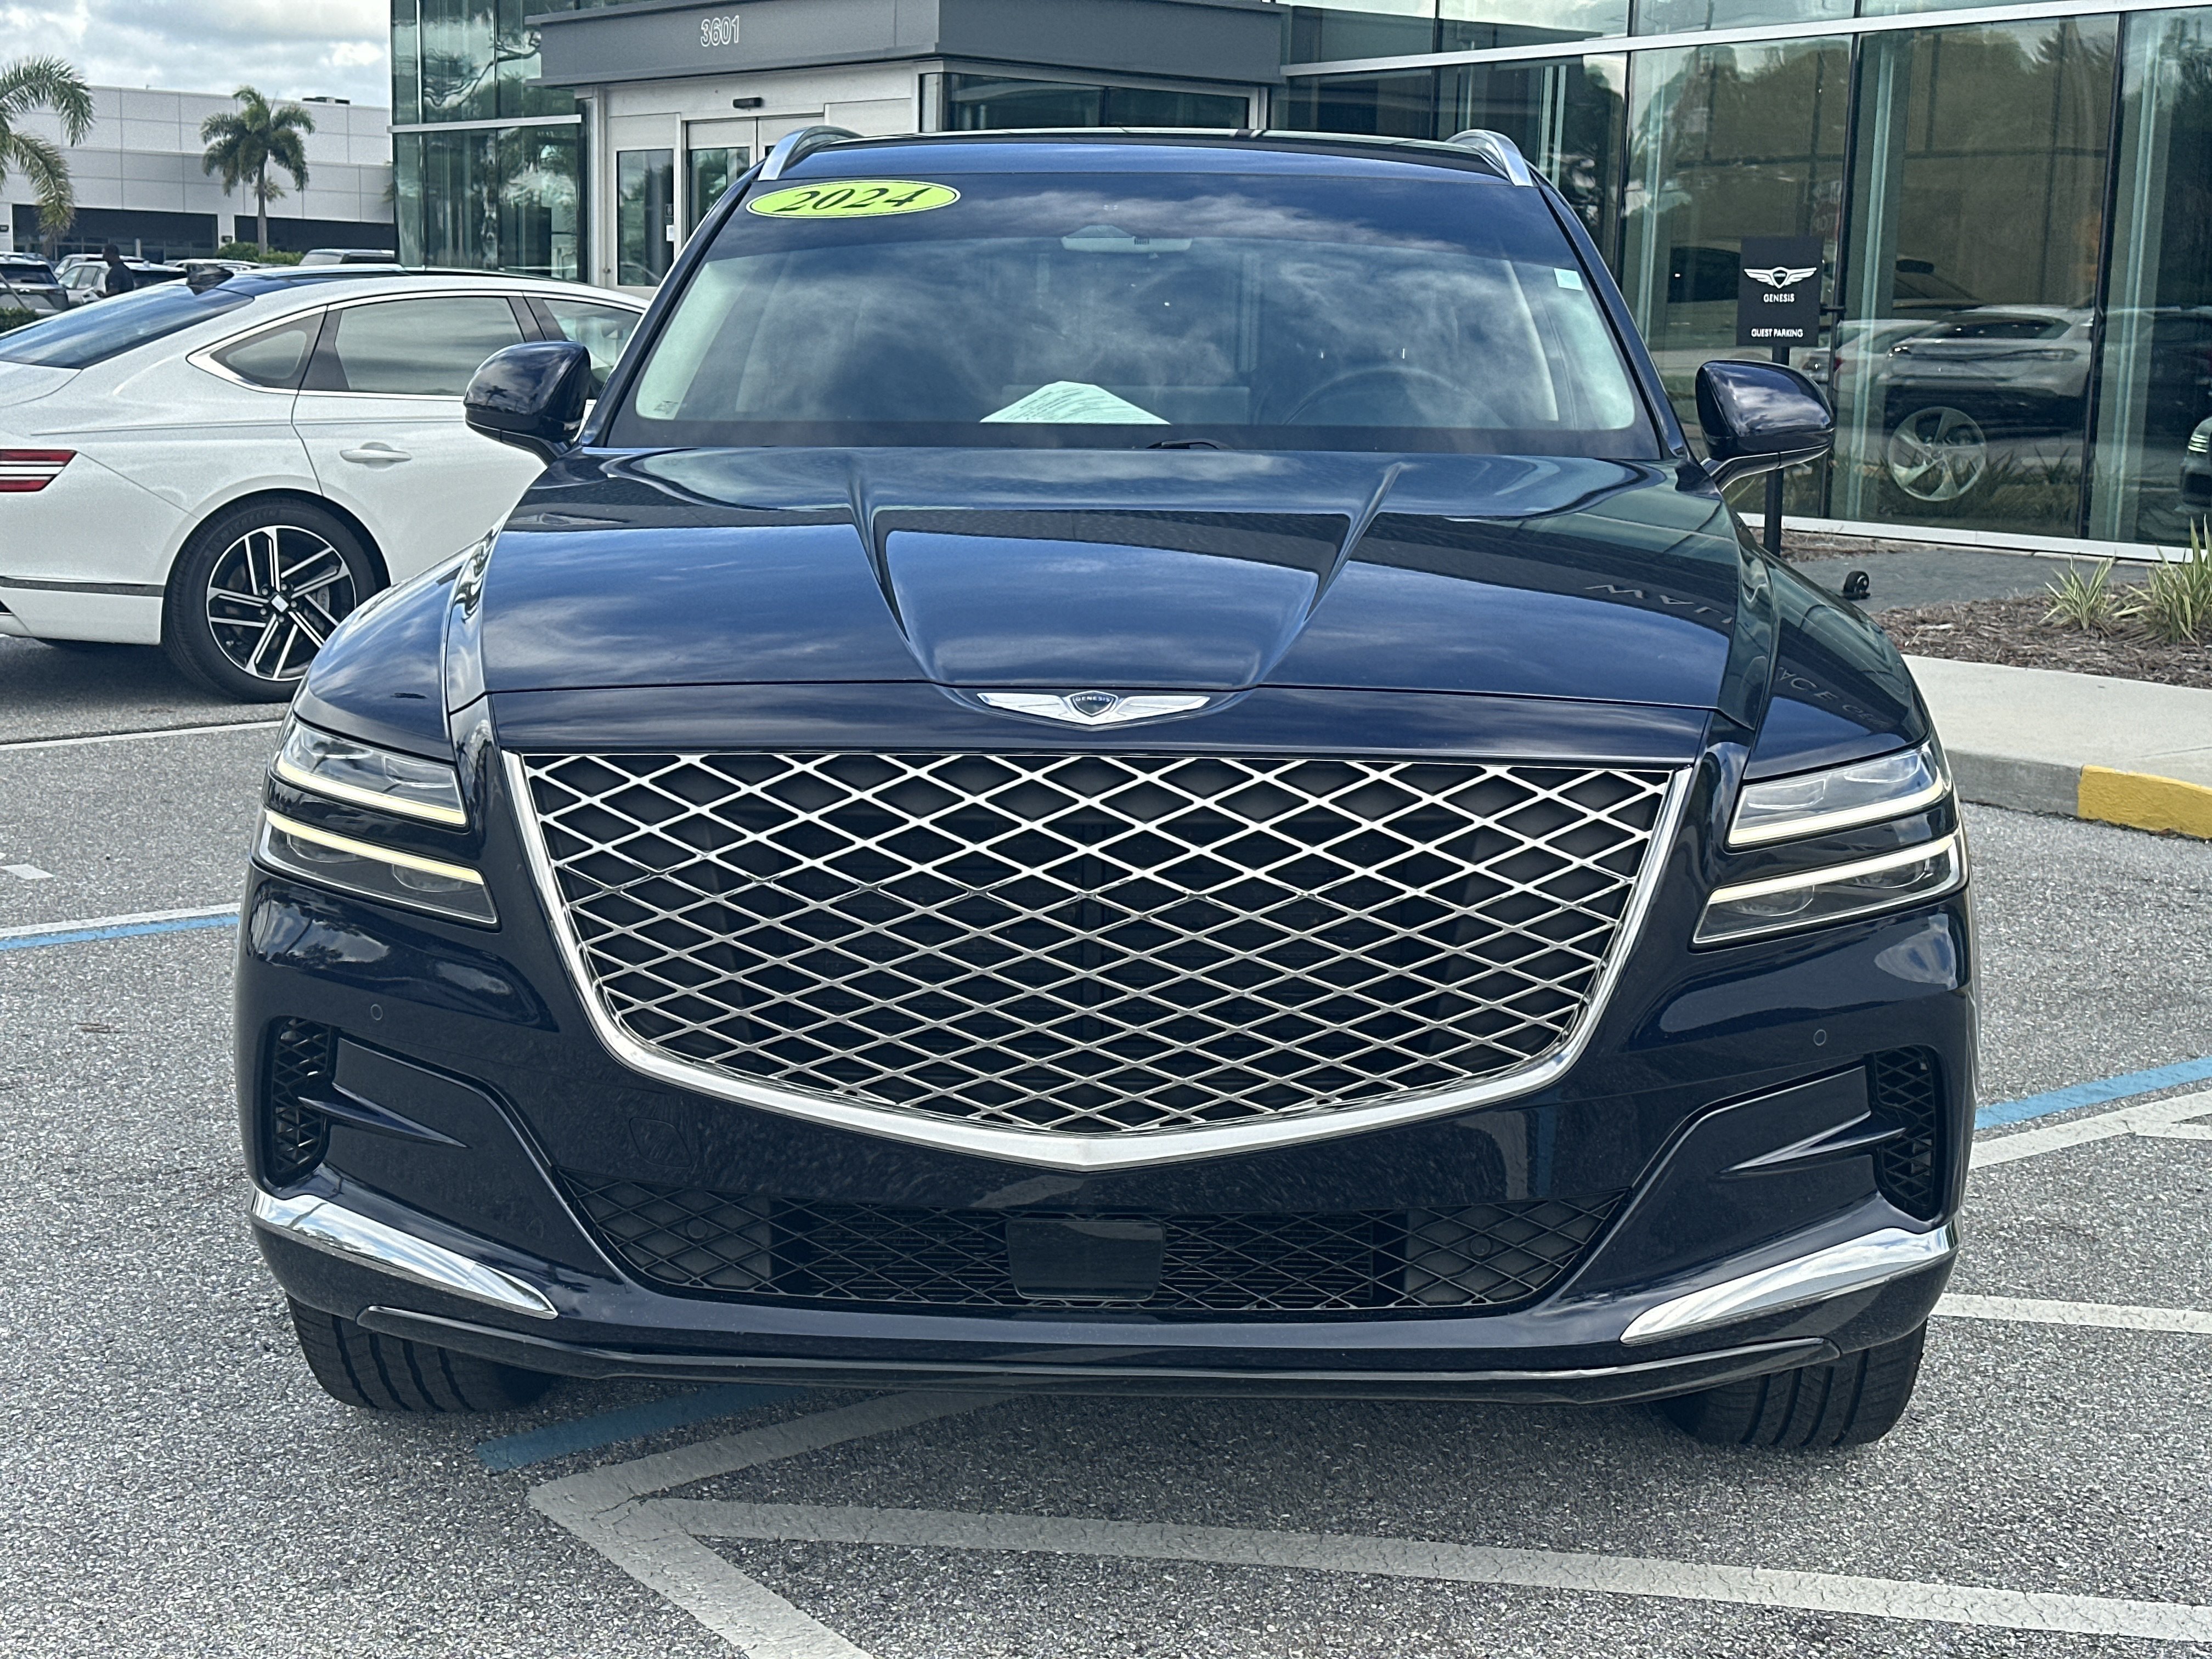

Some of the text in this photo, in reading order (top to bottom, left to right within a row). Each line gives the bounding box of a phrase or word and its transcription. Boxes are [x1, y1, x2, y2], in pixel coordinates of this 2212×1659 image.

[701, 15, 740, 47] 3601
[772, 187, 933, 212] 2024
[1763, 293, 1795, 303] GENESIS
[1751, 328, 1803, 338] GUEST PARKING
